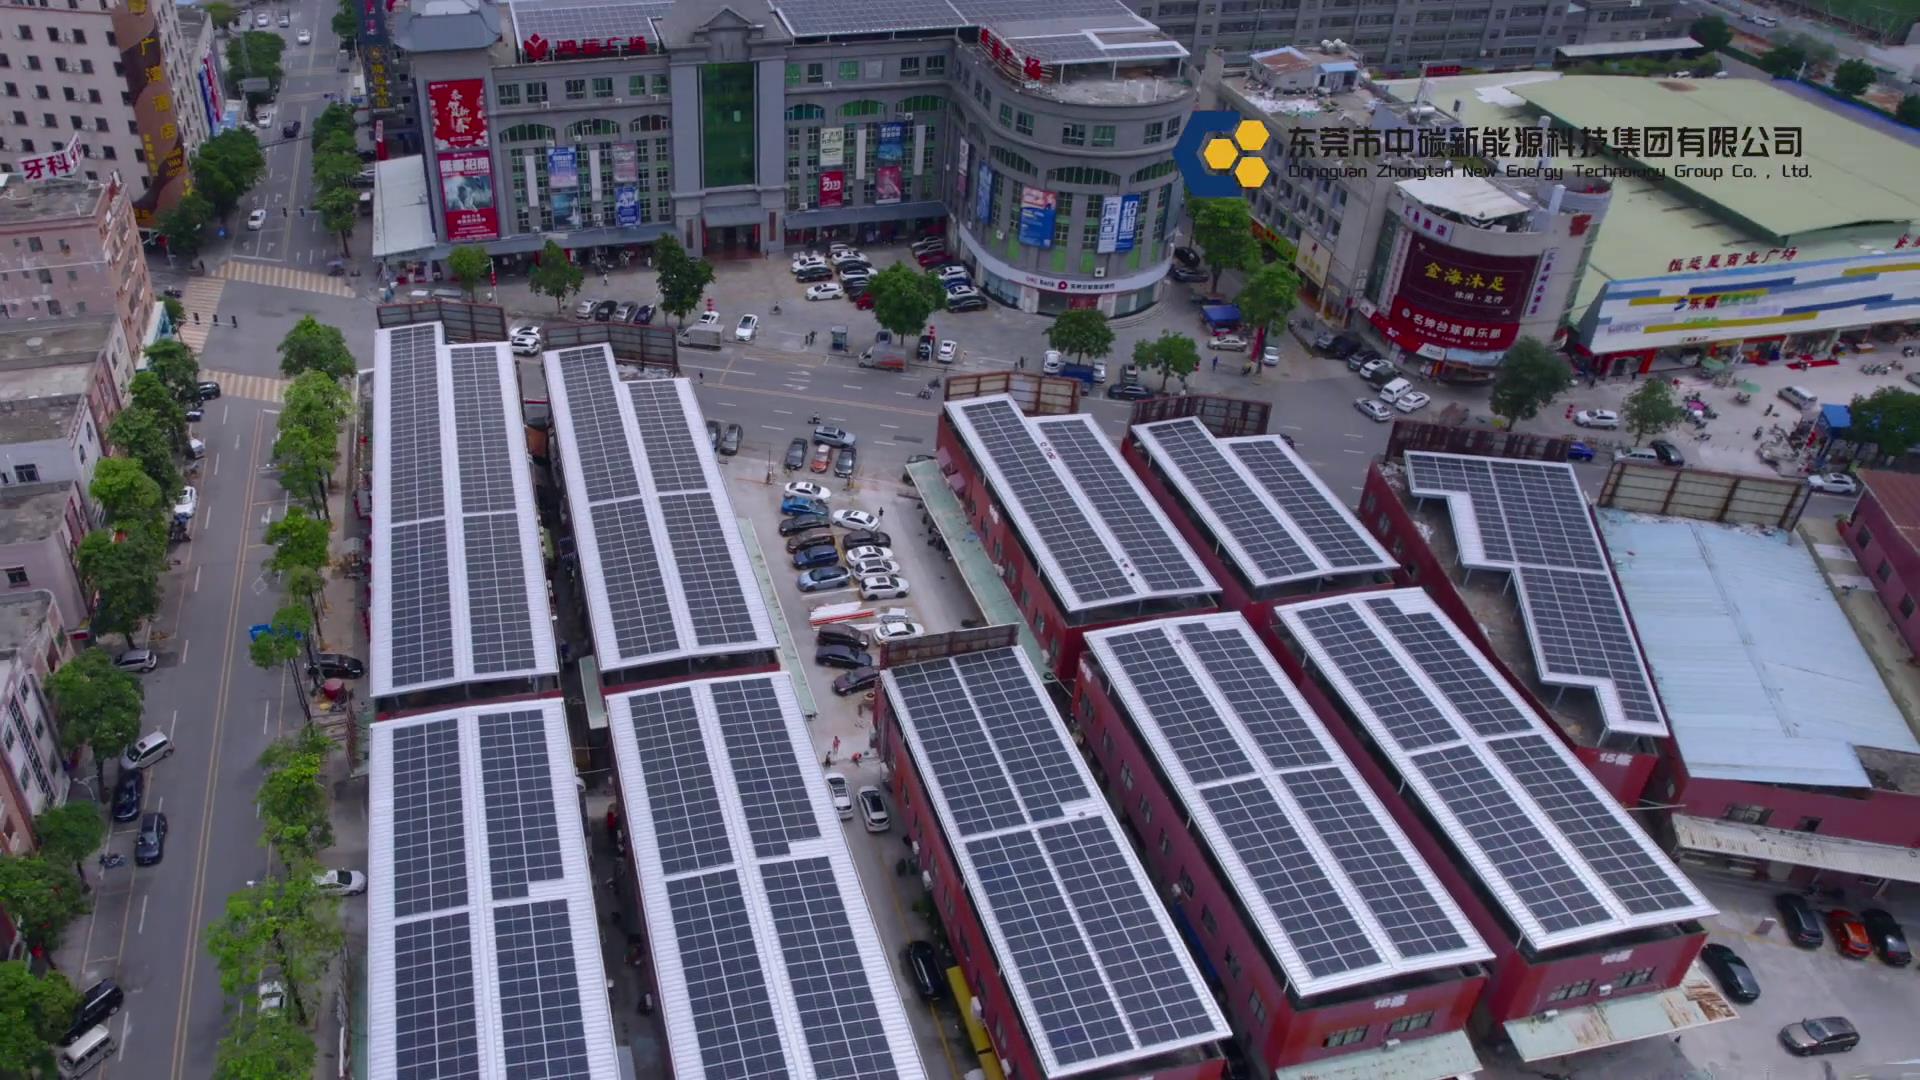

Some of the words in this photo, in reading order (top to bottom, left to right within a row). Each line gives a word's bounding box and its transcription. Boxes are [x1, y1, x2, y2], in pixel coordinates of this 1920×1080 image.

[21, 152, 71, 180] 牙科
[1424, 262, 1505, 292] 金海沐足
